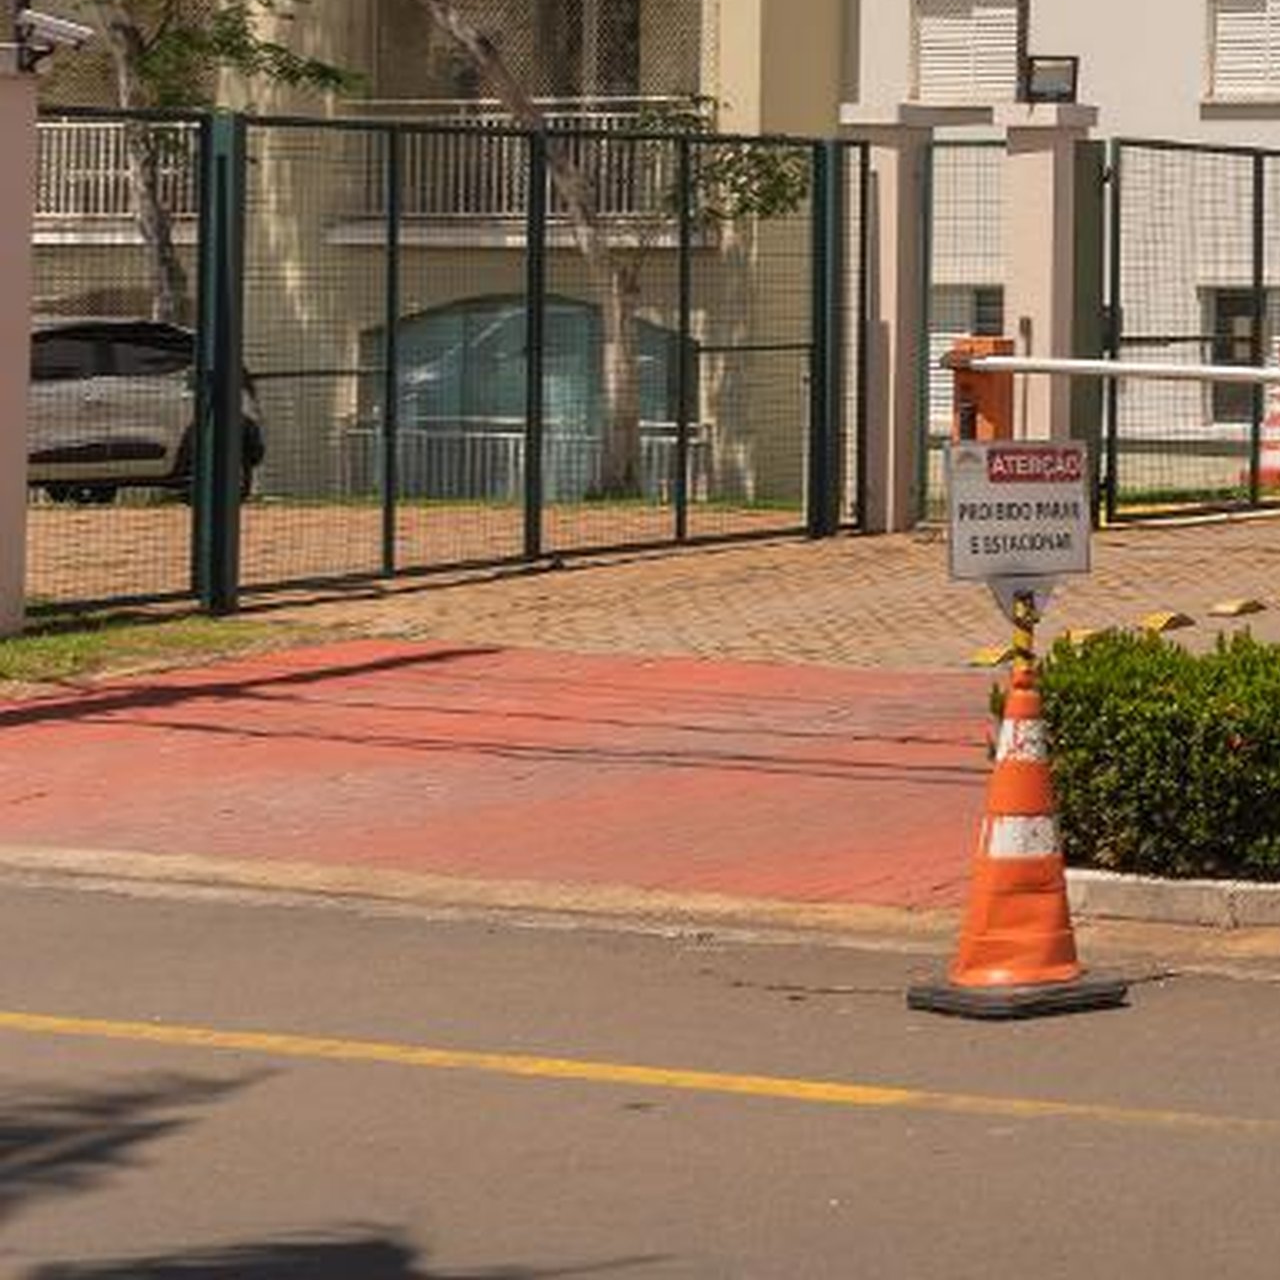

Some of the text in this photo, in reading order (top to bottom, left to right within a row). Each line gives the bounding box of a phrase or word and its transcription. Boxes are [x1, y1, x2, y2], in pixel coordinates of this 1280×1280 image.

[959, 502, 1032, 521] PROIBIDO
[970, 532, 1074, 554] E ESTACIONAR
